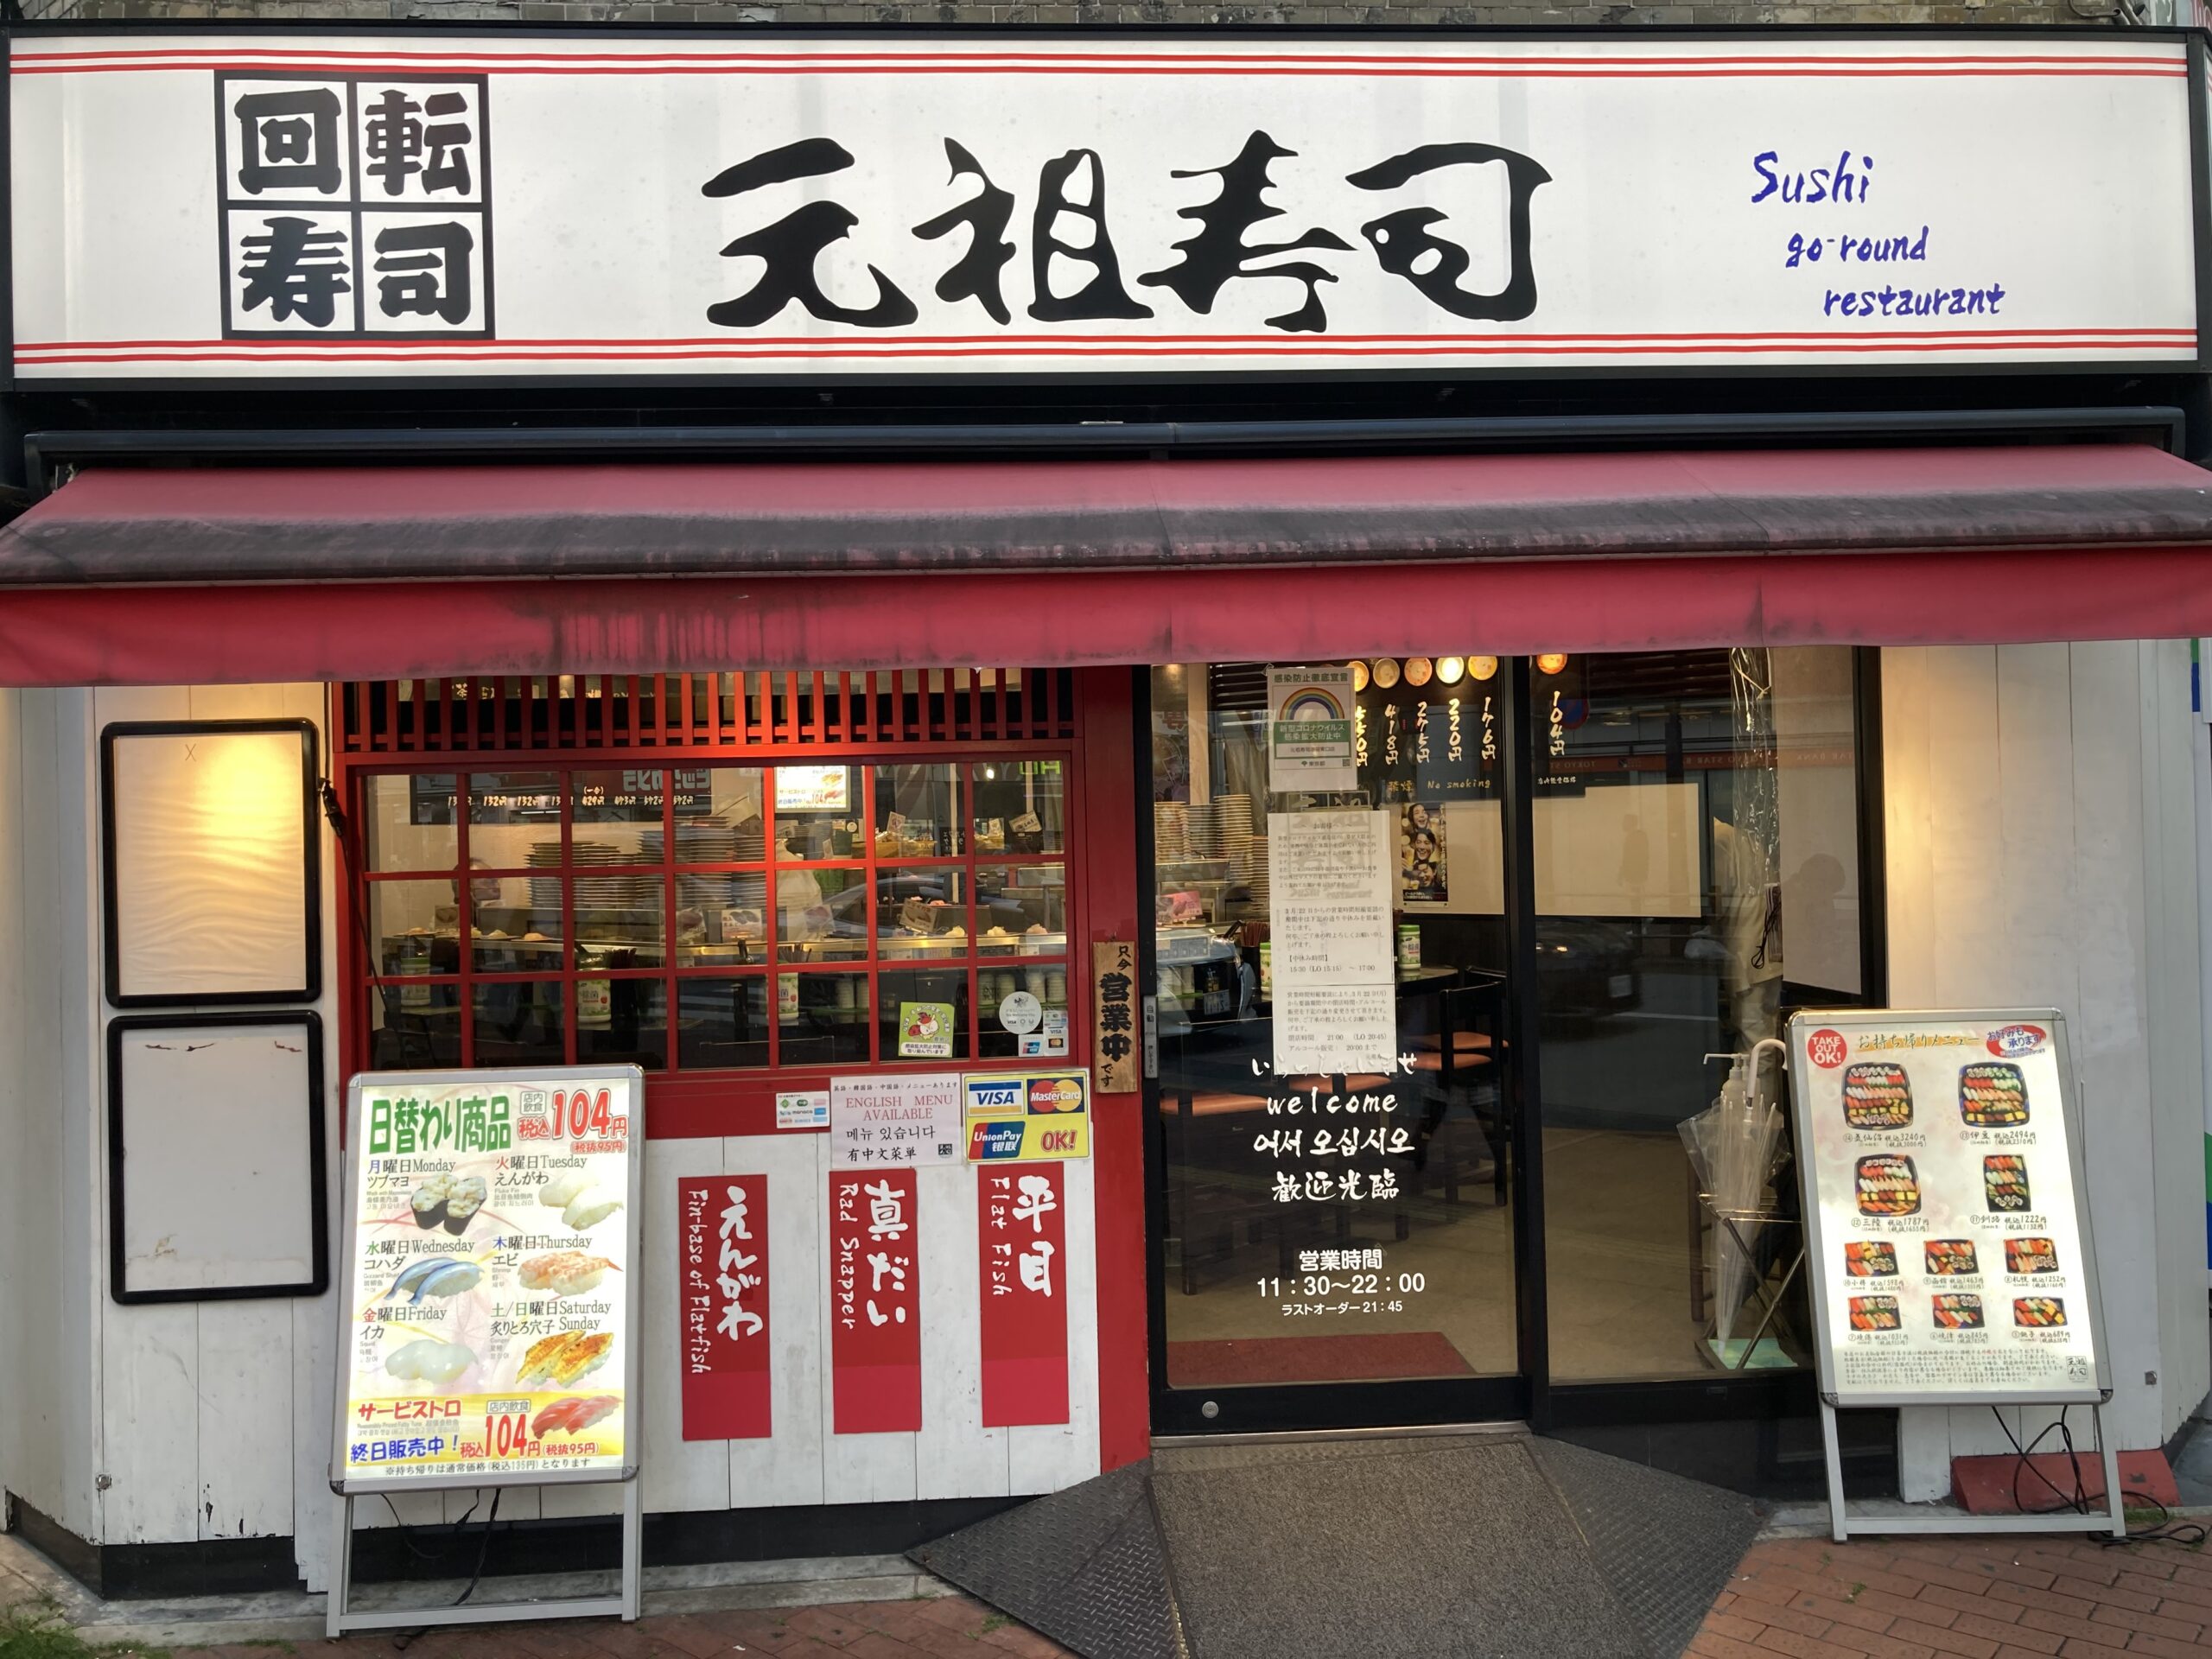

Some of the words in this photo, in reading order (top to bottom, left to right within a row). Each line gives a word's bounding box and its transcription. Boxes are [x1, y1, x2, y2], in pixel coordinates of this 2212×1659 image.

[234, 88, 472, 196] 回転
[1751, 150, 1873, 203] Sushi
[701, 130, 1553, 333] 元祖寿司
[1785, 226, 1929, 268] go-round
[240, 217, 474, 327] 寿司
[1823, 283, 2005, 316] restaurant
[1384, 703, 1399, 766] 418円
[1416, 701, 1430, 764] 275円
[1448, 698, 1462, 761] 220円
[1481, 696, 1496, 760] 176円
[1549, 690, 1565, 756] 104円
[1427, 779, 1440, 789] No
[1447, 779, 1491, 789] smoking
[1117, 945, 1133, 970] 只今
[1099, 973, 1132, 1062] 営業中
[1811, 1036, 1841, 1046] TAKE
[1859, 1033, 1980, 1049] お持ち帰りメニュー
[1986, 1027, 2024, 1041] お好みも
[2007, 1033, 2043, 1048] 承ります
[1814, 1052, 1842, 1064] OK!
[1815, 1045, 1838, 1053] OUT
[1100, 1064, 1115, 1087] です
[846, 1096, 902, 1109] ENGLISH
[914, 1094, 953, 1106] MENU
[976, 1091, 1014, 1106] VISA
[1030, 1090, 1081, 1103] MasterCard
[1267, 1086, 1398, 1116] welcome
[369, 1095, 512, 1154] 日替わり商品
[863, 1109, 934, 1122] AVAILABLE
[847, 1127, 874, 1141] 메뉴
[880, 1124, 936, 1140] 있습니다
[974, 1130, 1022, 1144] UnionPay
[1041, 1130, 1077, 1152] OK!
[1253, 1129, 1302, 1158] 어서
[1309, 1127, 1415, 1156] 오십시오
[495, 1171, 550, 1186] えんがわ
[990, 1177, 1010, 1230] Flat
[689, 1189, 709, 1265] Fin-base
[1013, 1175, 1057, 1297] 平目
[364, 1255, 406, 1270] コハダ
[492, 1253, 518, 1267] エビ
[716, 1185, 763, 1341] えんがわ
[864, 1179, 909, 1326] 真だい
[1299, 1249, 1382, 1272] 営業時間
[690, 1270, 710, 1291] of
[991, 1243, 1013, 1296] Fish
[837, 1236, 860, 1330] Snapper
[359, 1325, 385, 1340] イカ
[490, 1319, 555, 1337] 炙りとろ穴子
[559, 1316, 601, 1331] Sunday
[690, 1294, 711, 1374] Flatfish
[359, 1400, 461, 1421] サービストロ
[489, 1402, 529, 1412] 店内飲食
